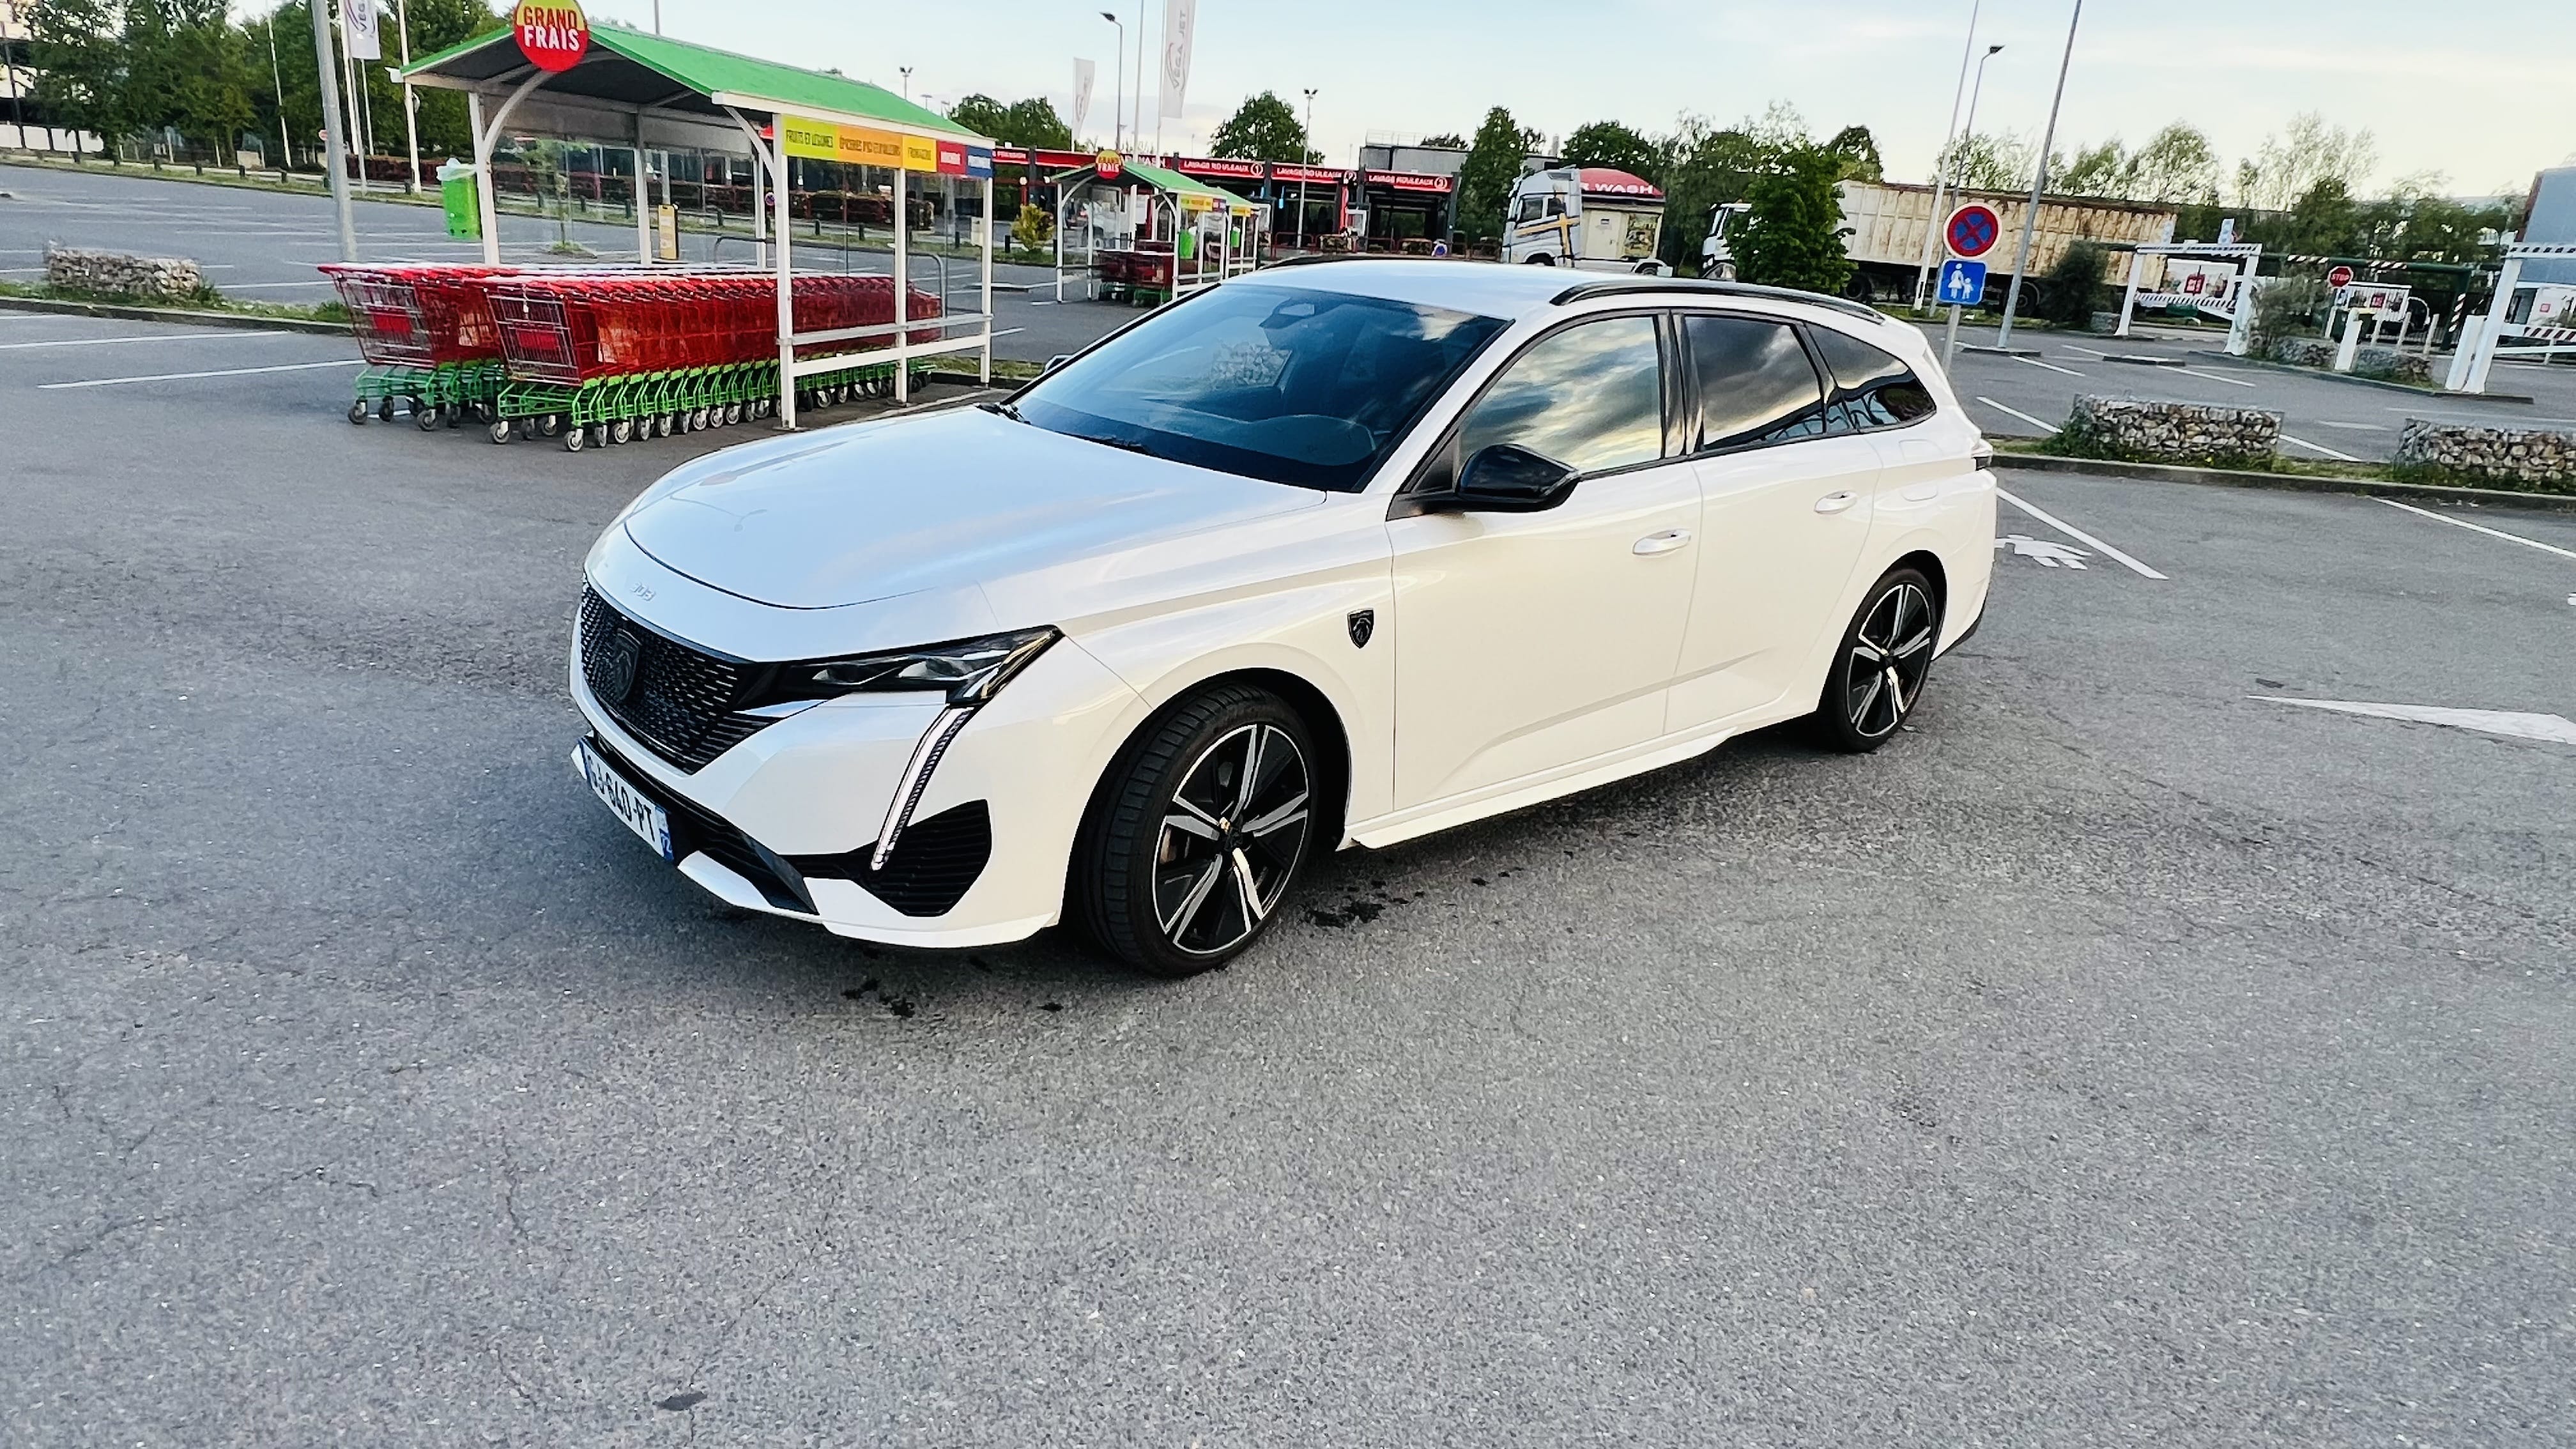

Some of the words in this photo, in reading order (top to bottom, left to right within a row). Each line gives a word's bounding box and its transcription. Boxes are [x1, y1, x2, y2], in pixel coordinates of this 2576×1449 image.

[524, 6, 578, 28] GRAND
[524, 25, 579, 51] FRAIS
[1098, 163, 1119, 172] FRAIS
[1184, 160, 1209, 169] LAVAGE
[1211, 162, 1249, 172] ROULEAUX
[1369, 174, 1395, 183] LAVAGE
[1396, 176, 1434, 185] ROULEAUX
[1595, 183, 1653, 194] WASH
[2331, 273, 2350, 281] STOP
